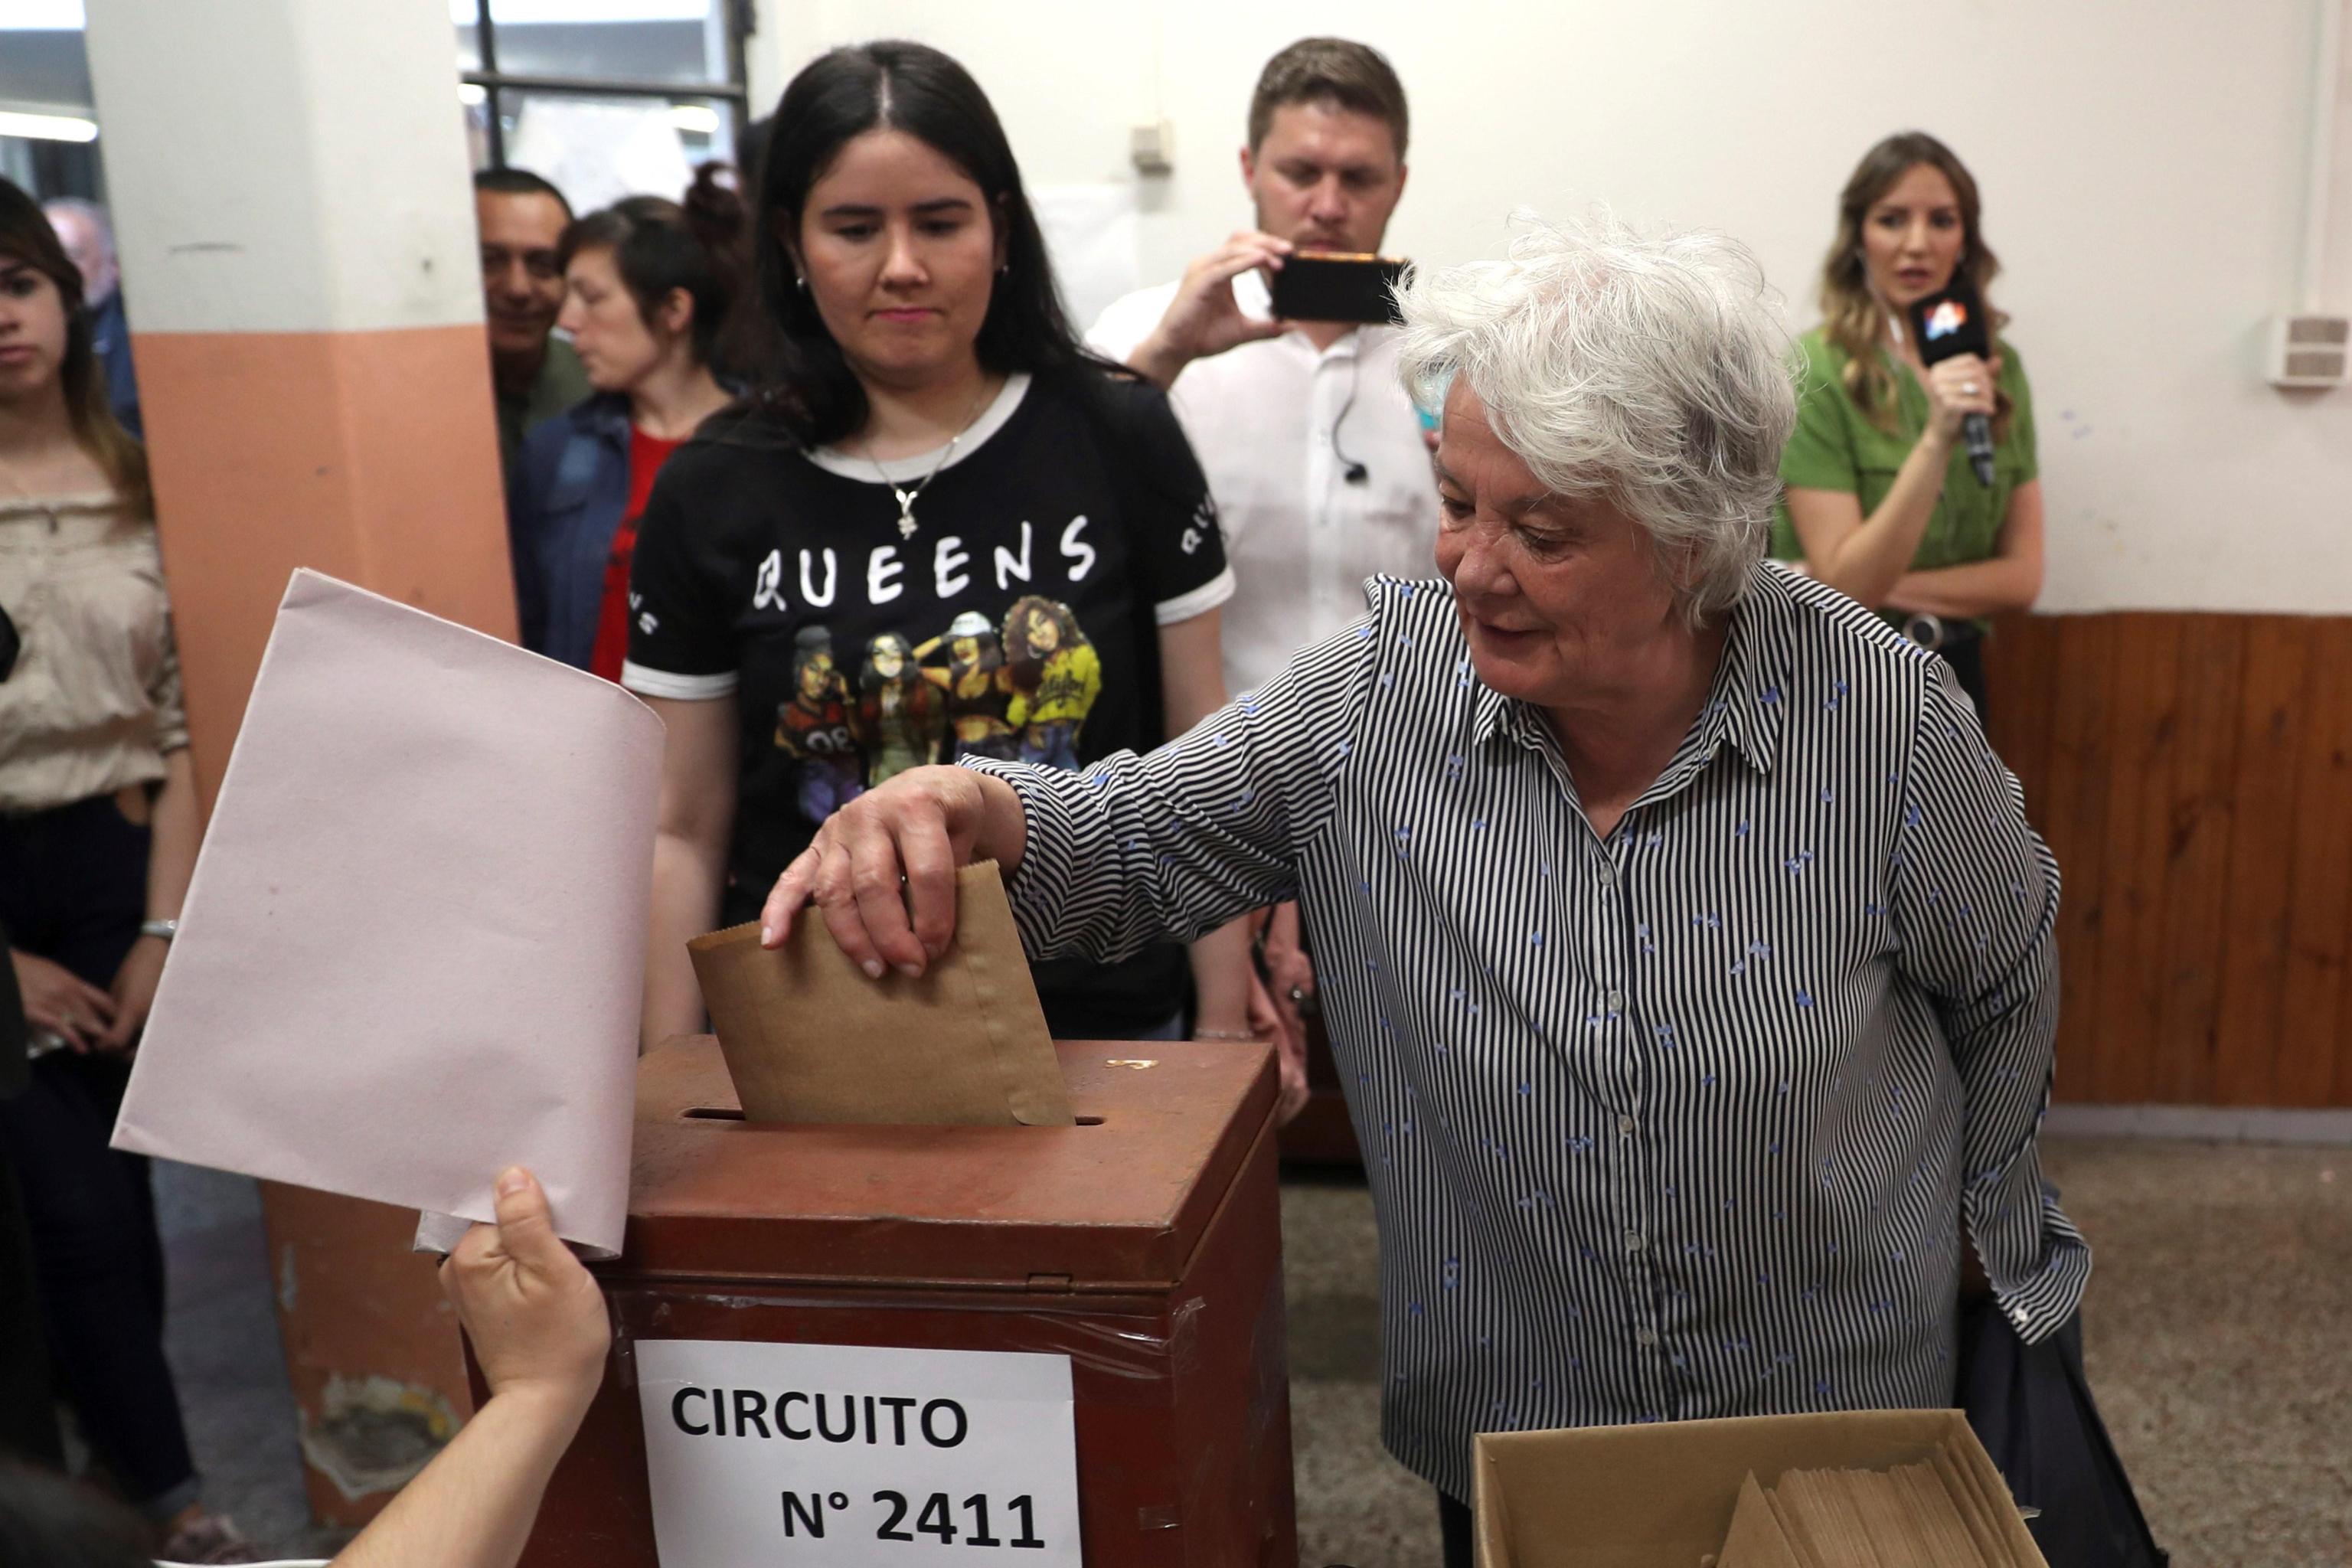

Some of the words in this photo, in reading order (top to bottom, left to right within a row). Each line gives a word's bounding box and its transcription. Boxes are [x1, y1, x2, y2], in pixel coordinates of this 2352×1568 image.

[753, 514, 1096, 611] QUEENS
[671, 1387, 968, 1448] CIRCUITO
[782, 1491, 849, 1538] N°
[872, 1490, 1045, 1548] 2411
